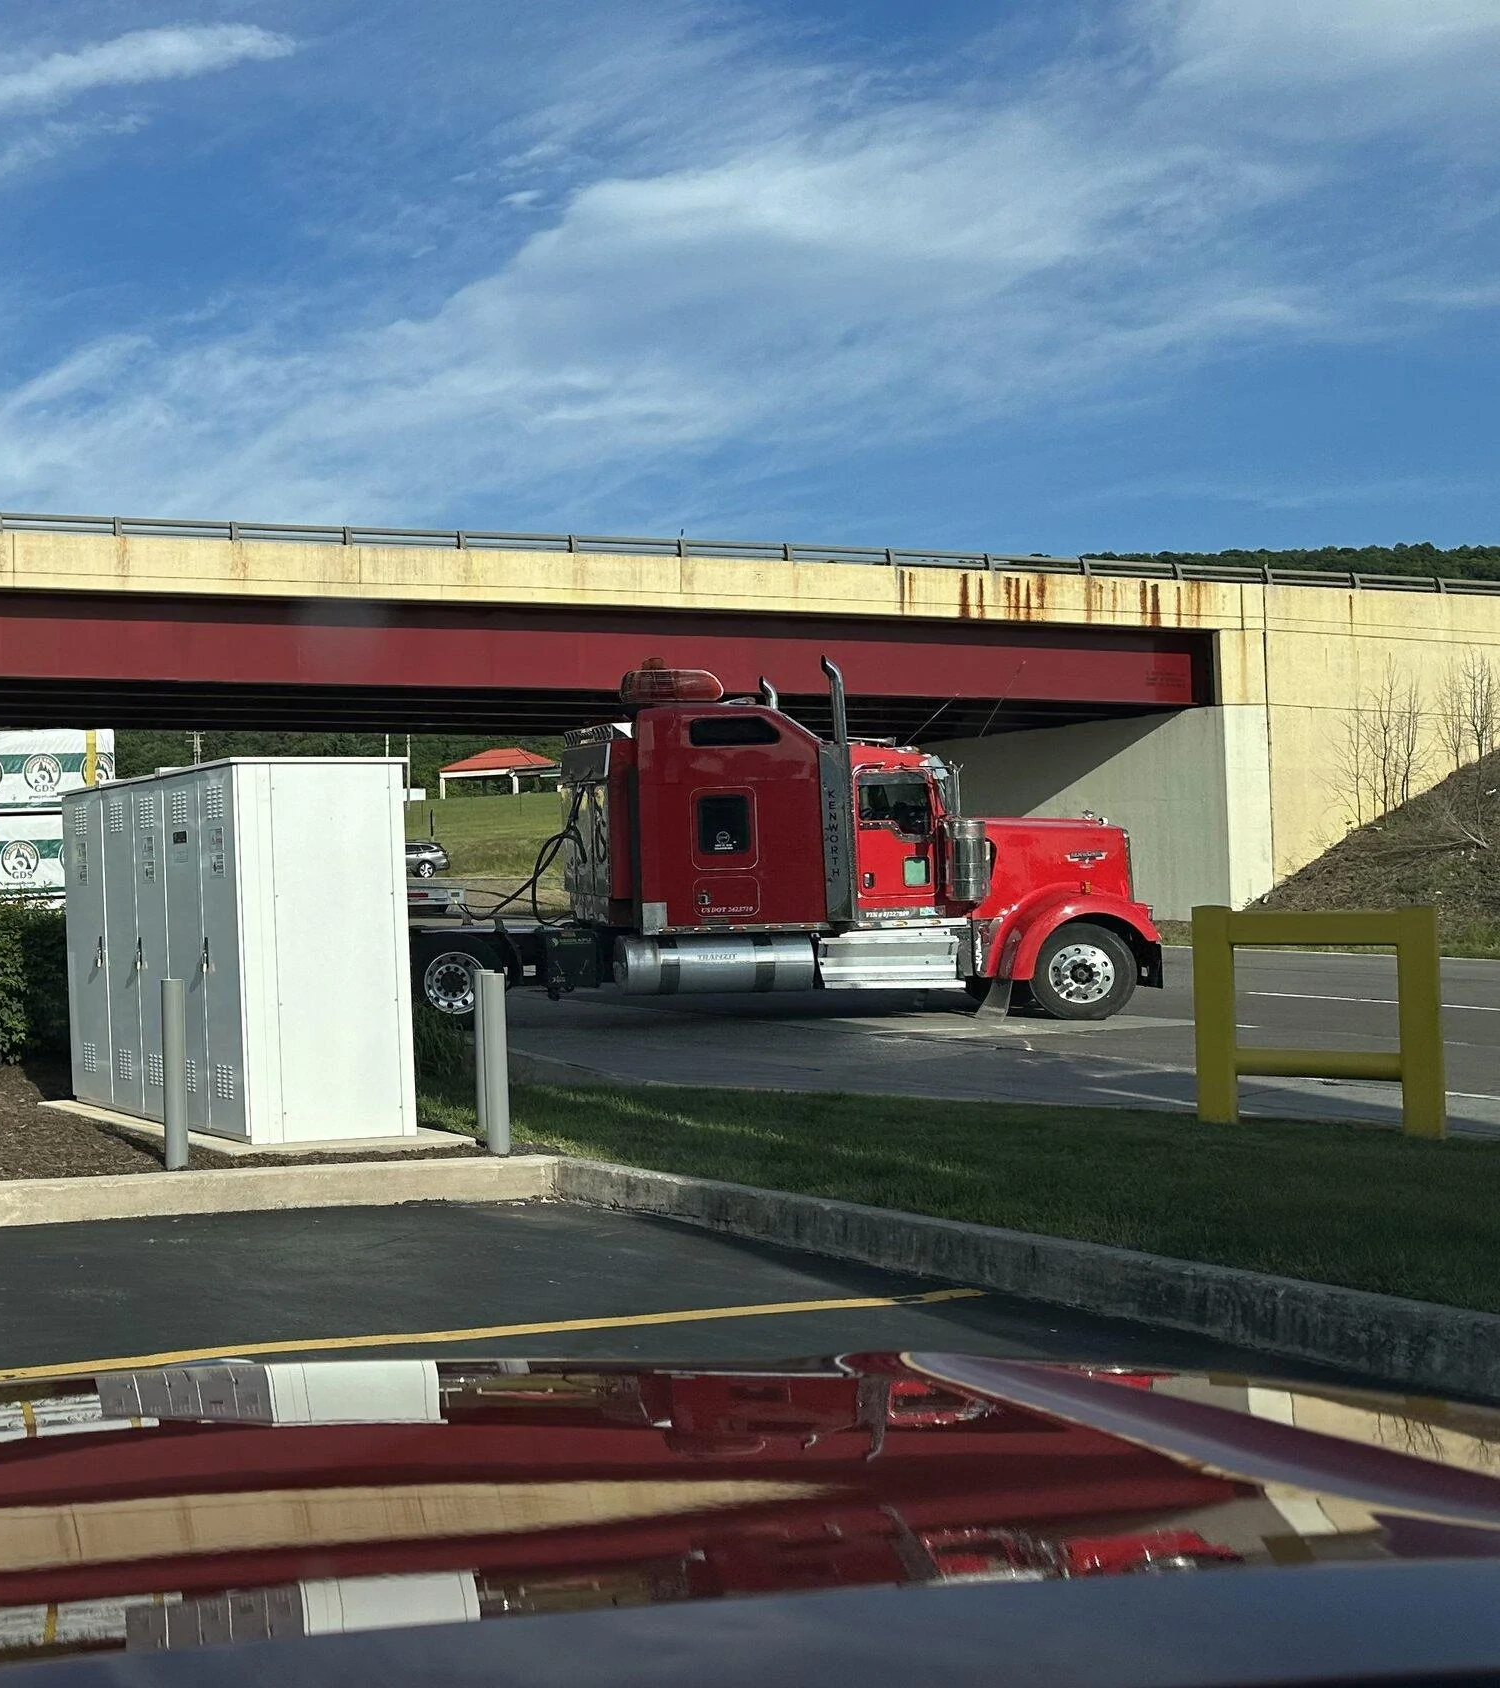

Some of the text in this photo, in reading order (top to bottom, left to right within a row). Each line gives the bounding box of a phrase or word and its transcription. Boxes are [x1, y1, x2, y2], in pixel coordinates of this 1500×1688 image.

[34, 784, 55, 793] GDS
[828, 789, 840, 877] KENWORTH
[12, 870, 33, 880] GDS
